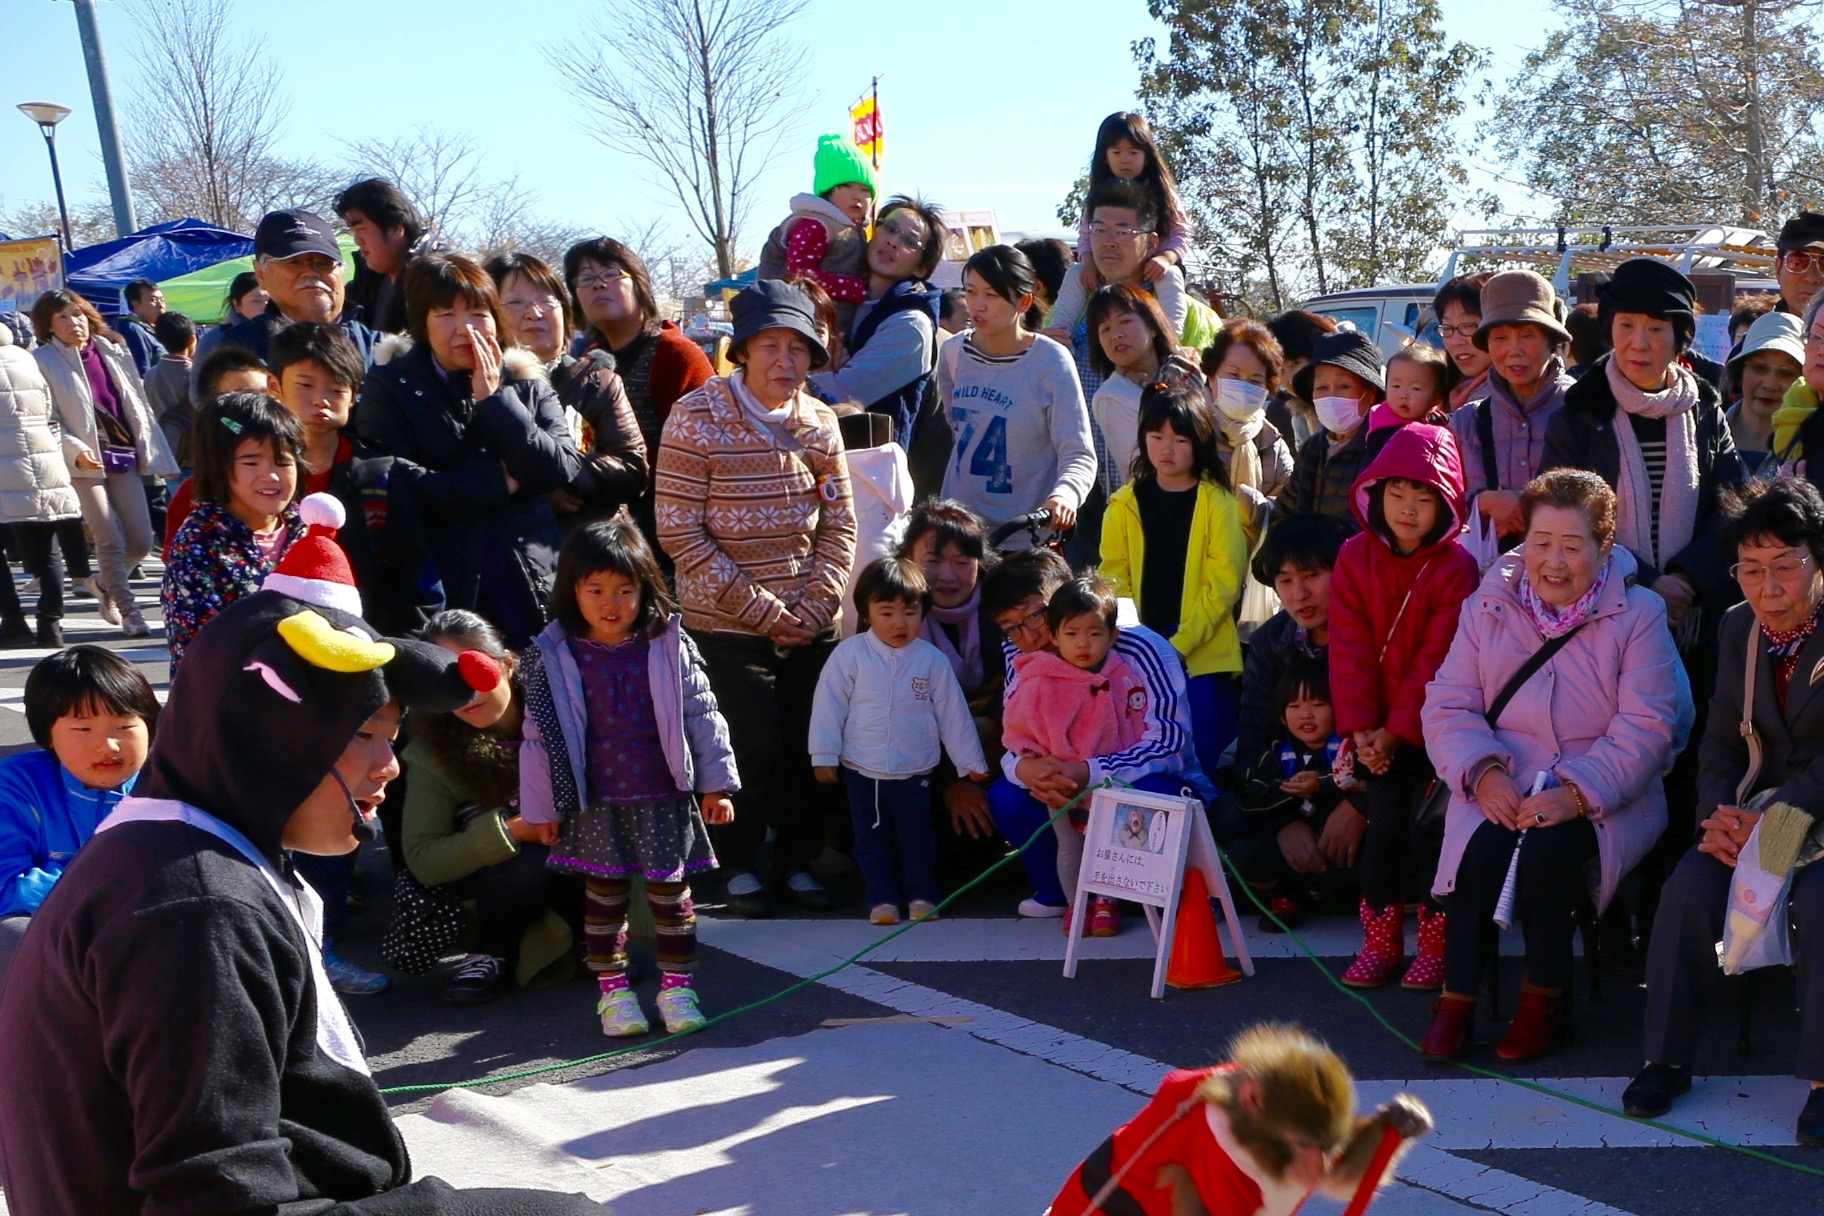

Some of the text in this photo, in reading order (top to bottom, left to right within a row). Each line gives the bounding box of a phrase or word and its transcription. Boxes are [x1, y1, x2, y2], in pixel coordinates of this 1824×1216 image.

[953, 385, 1014, 411] WILD HEART
[951, 407, 1013, 494] 74
[1092, 871, 1169, 894] 手を出さないで下さい
